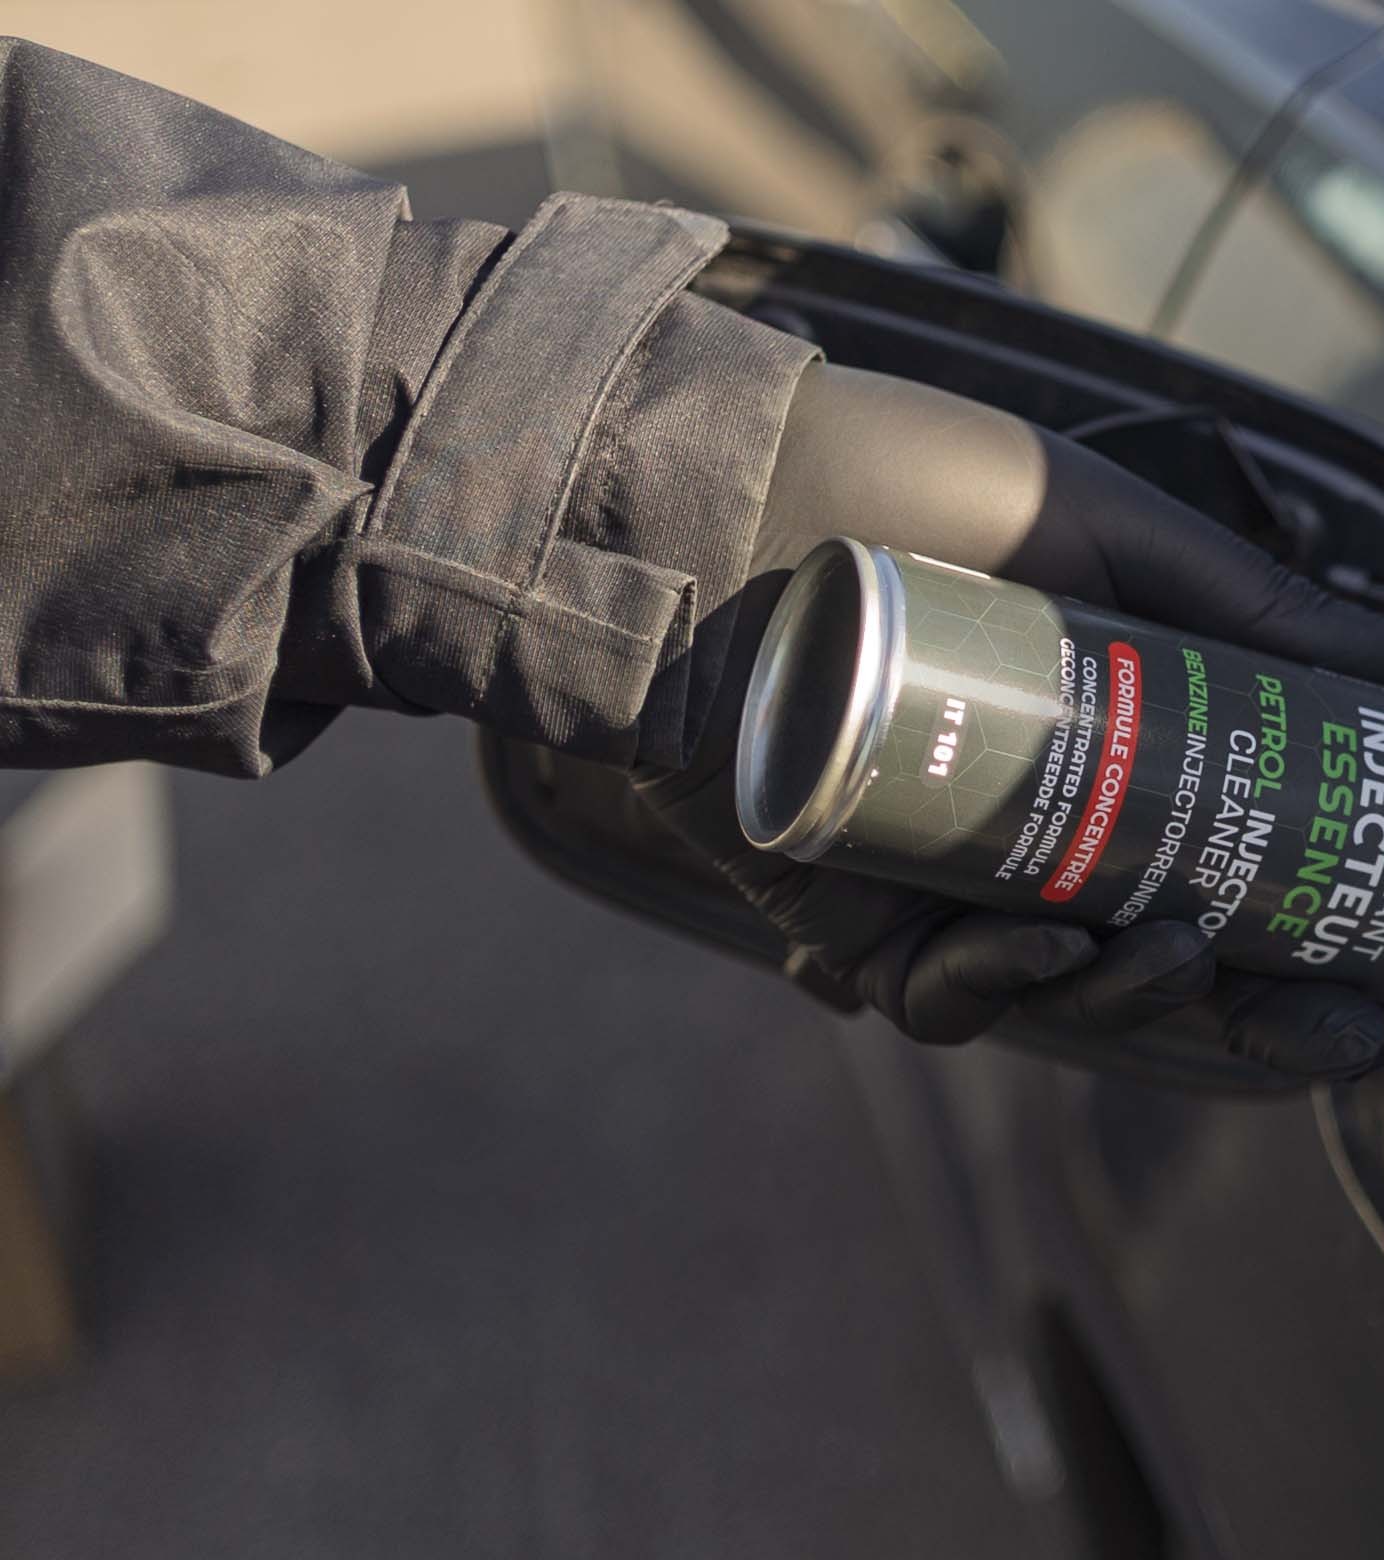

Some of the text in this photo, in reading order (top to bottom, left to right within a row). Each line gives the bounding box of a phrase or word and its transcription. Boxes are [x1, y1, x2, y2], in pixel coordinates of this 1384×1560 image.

[927, 698, 966, 777] IT 101
[995, 637, 1076, 881] GECONCENTREERDE FORMULE
[1023, 656, 1097, 876] CONCENTRATED FORMULA
[1055, 657, 1136, 892] FORMULE CONCENTRÉE
[1106, 648, 1208, 928] BENZINEINJECTORREINIGER
[1189, 729, 1256, 888] CLEANER
[1256, 674, 1287, 799] PETROL
[1267, 721, 1357, 938] ESSENCE
